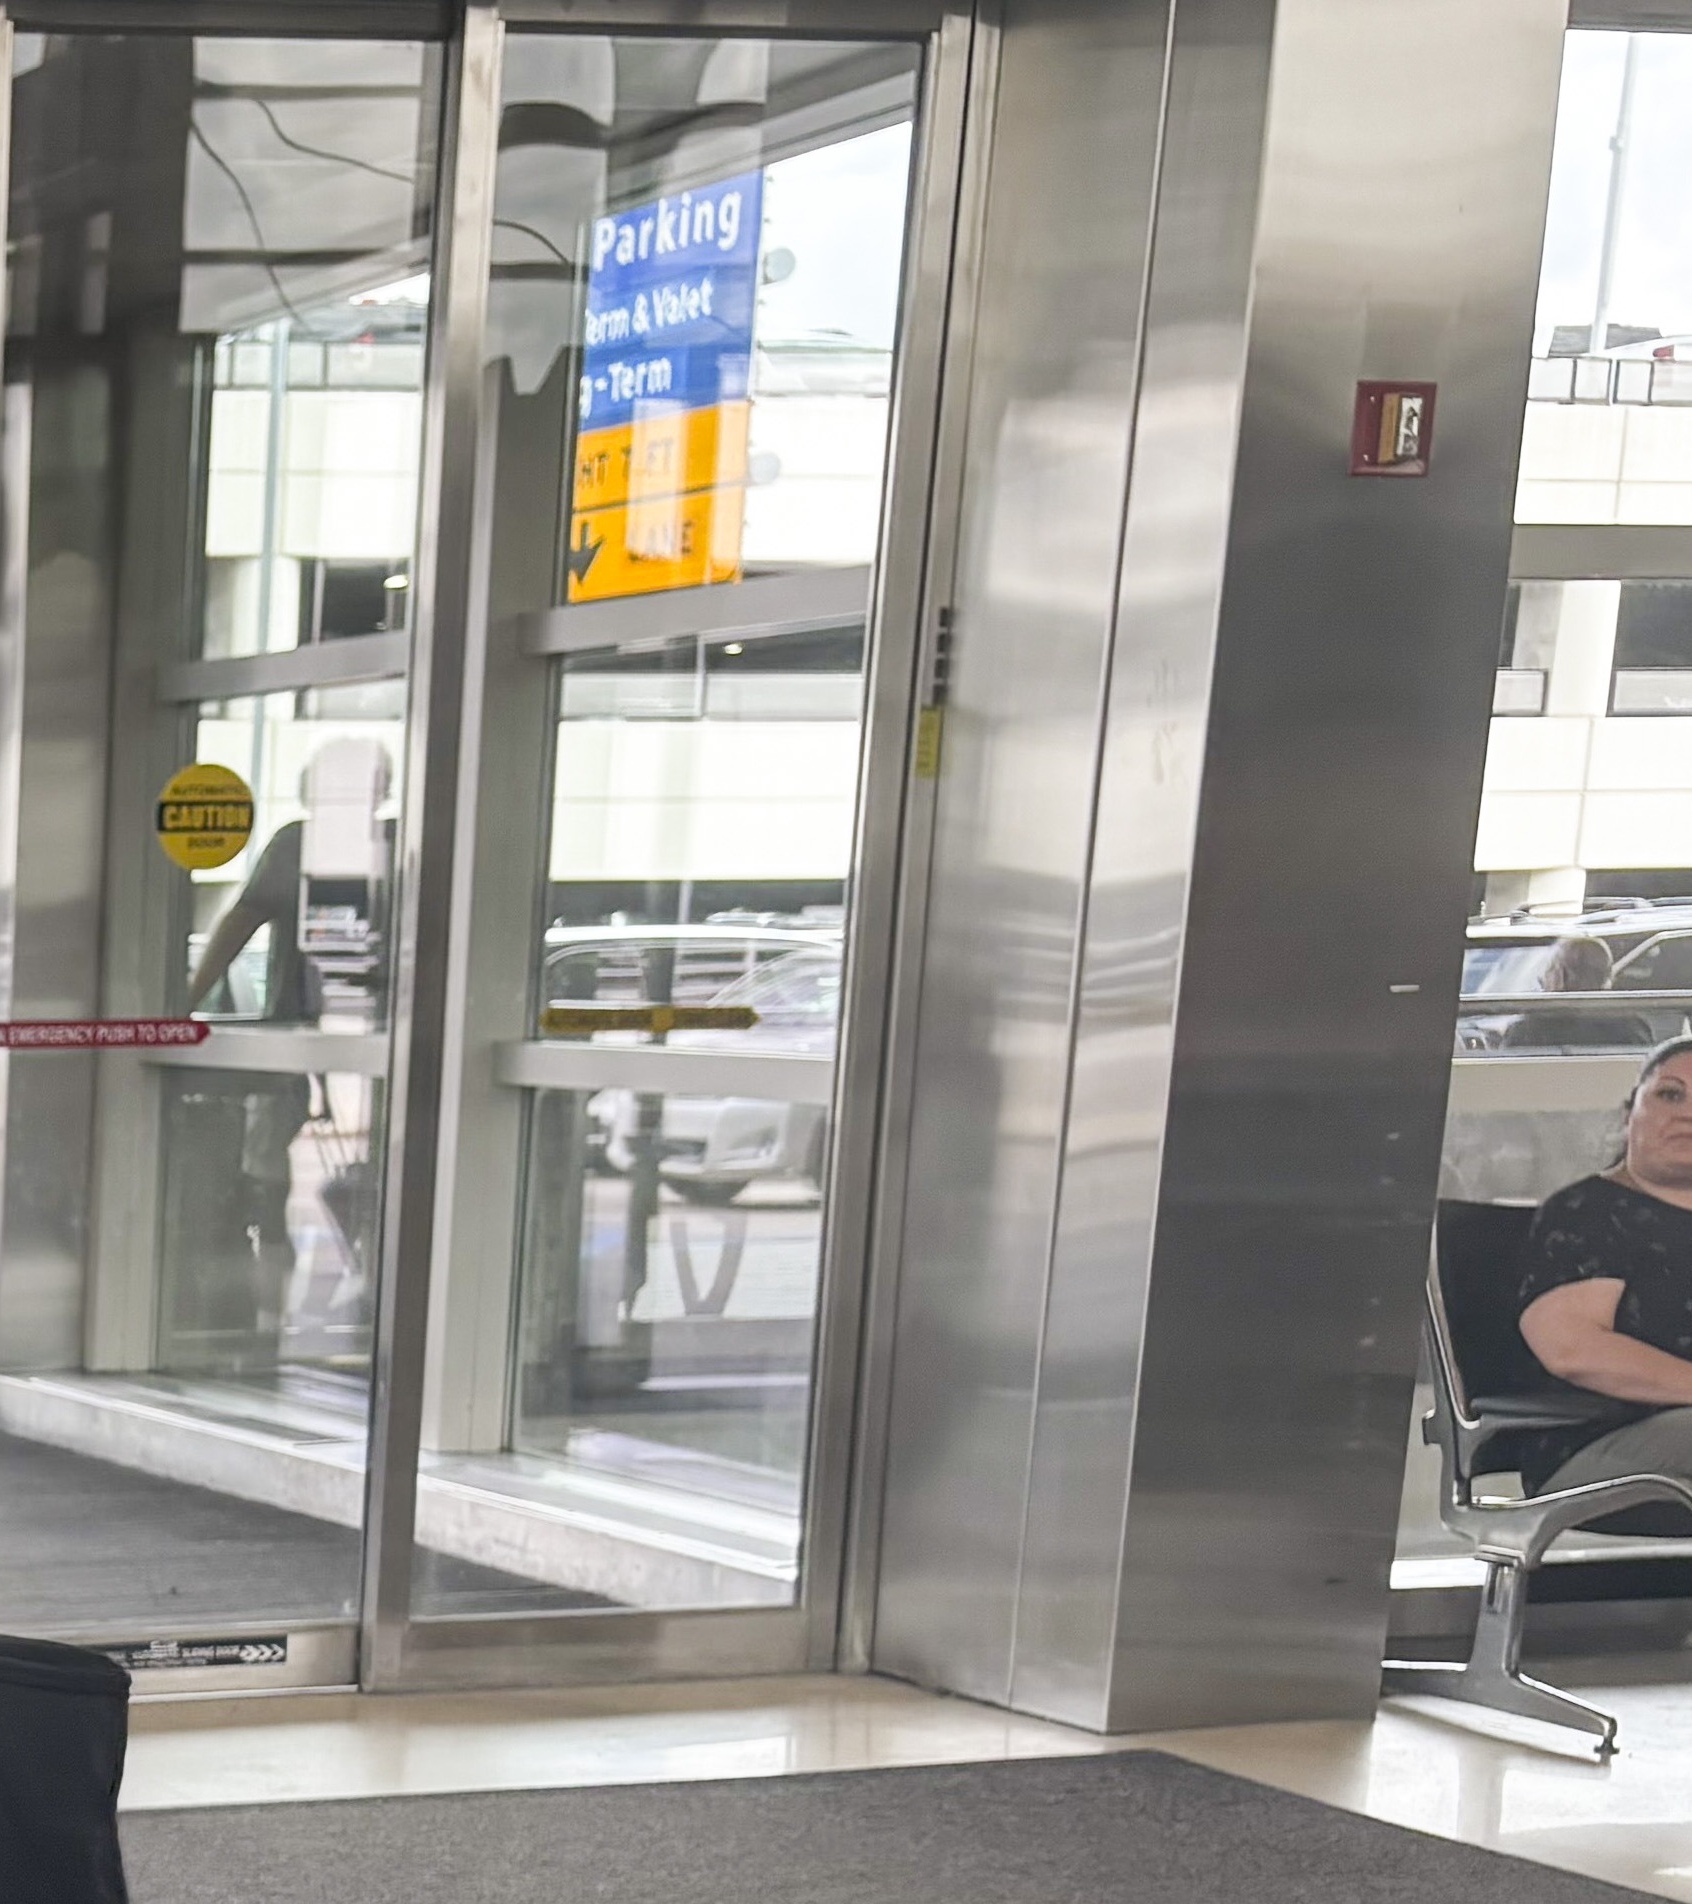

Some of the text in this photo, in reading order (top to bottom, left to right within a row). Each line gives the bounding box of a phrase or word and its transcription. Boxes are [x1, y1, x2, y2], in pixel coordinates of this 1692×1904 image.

[592, 191, 742, 272] Parking
[584, 276, 713, 347] erm & Valet
[164, 804, 252, 830] CAUTION
[8, 1026, 93, 1045] EMERGENCY
[96, 1024, 134, 1043] PUSH
[137, 1024, 156, 1043] TO
[158, 1023, 197, 1042] OPEN
